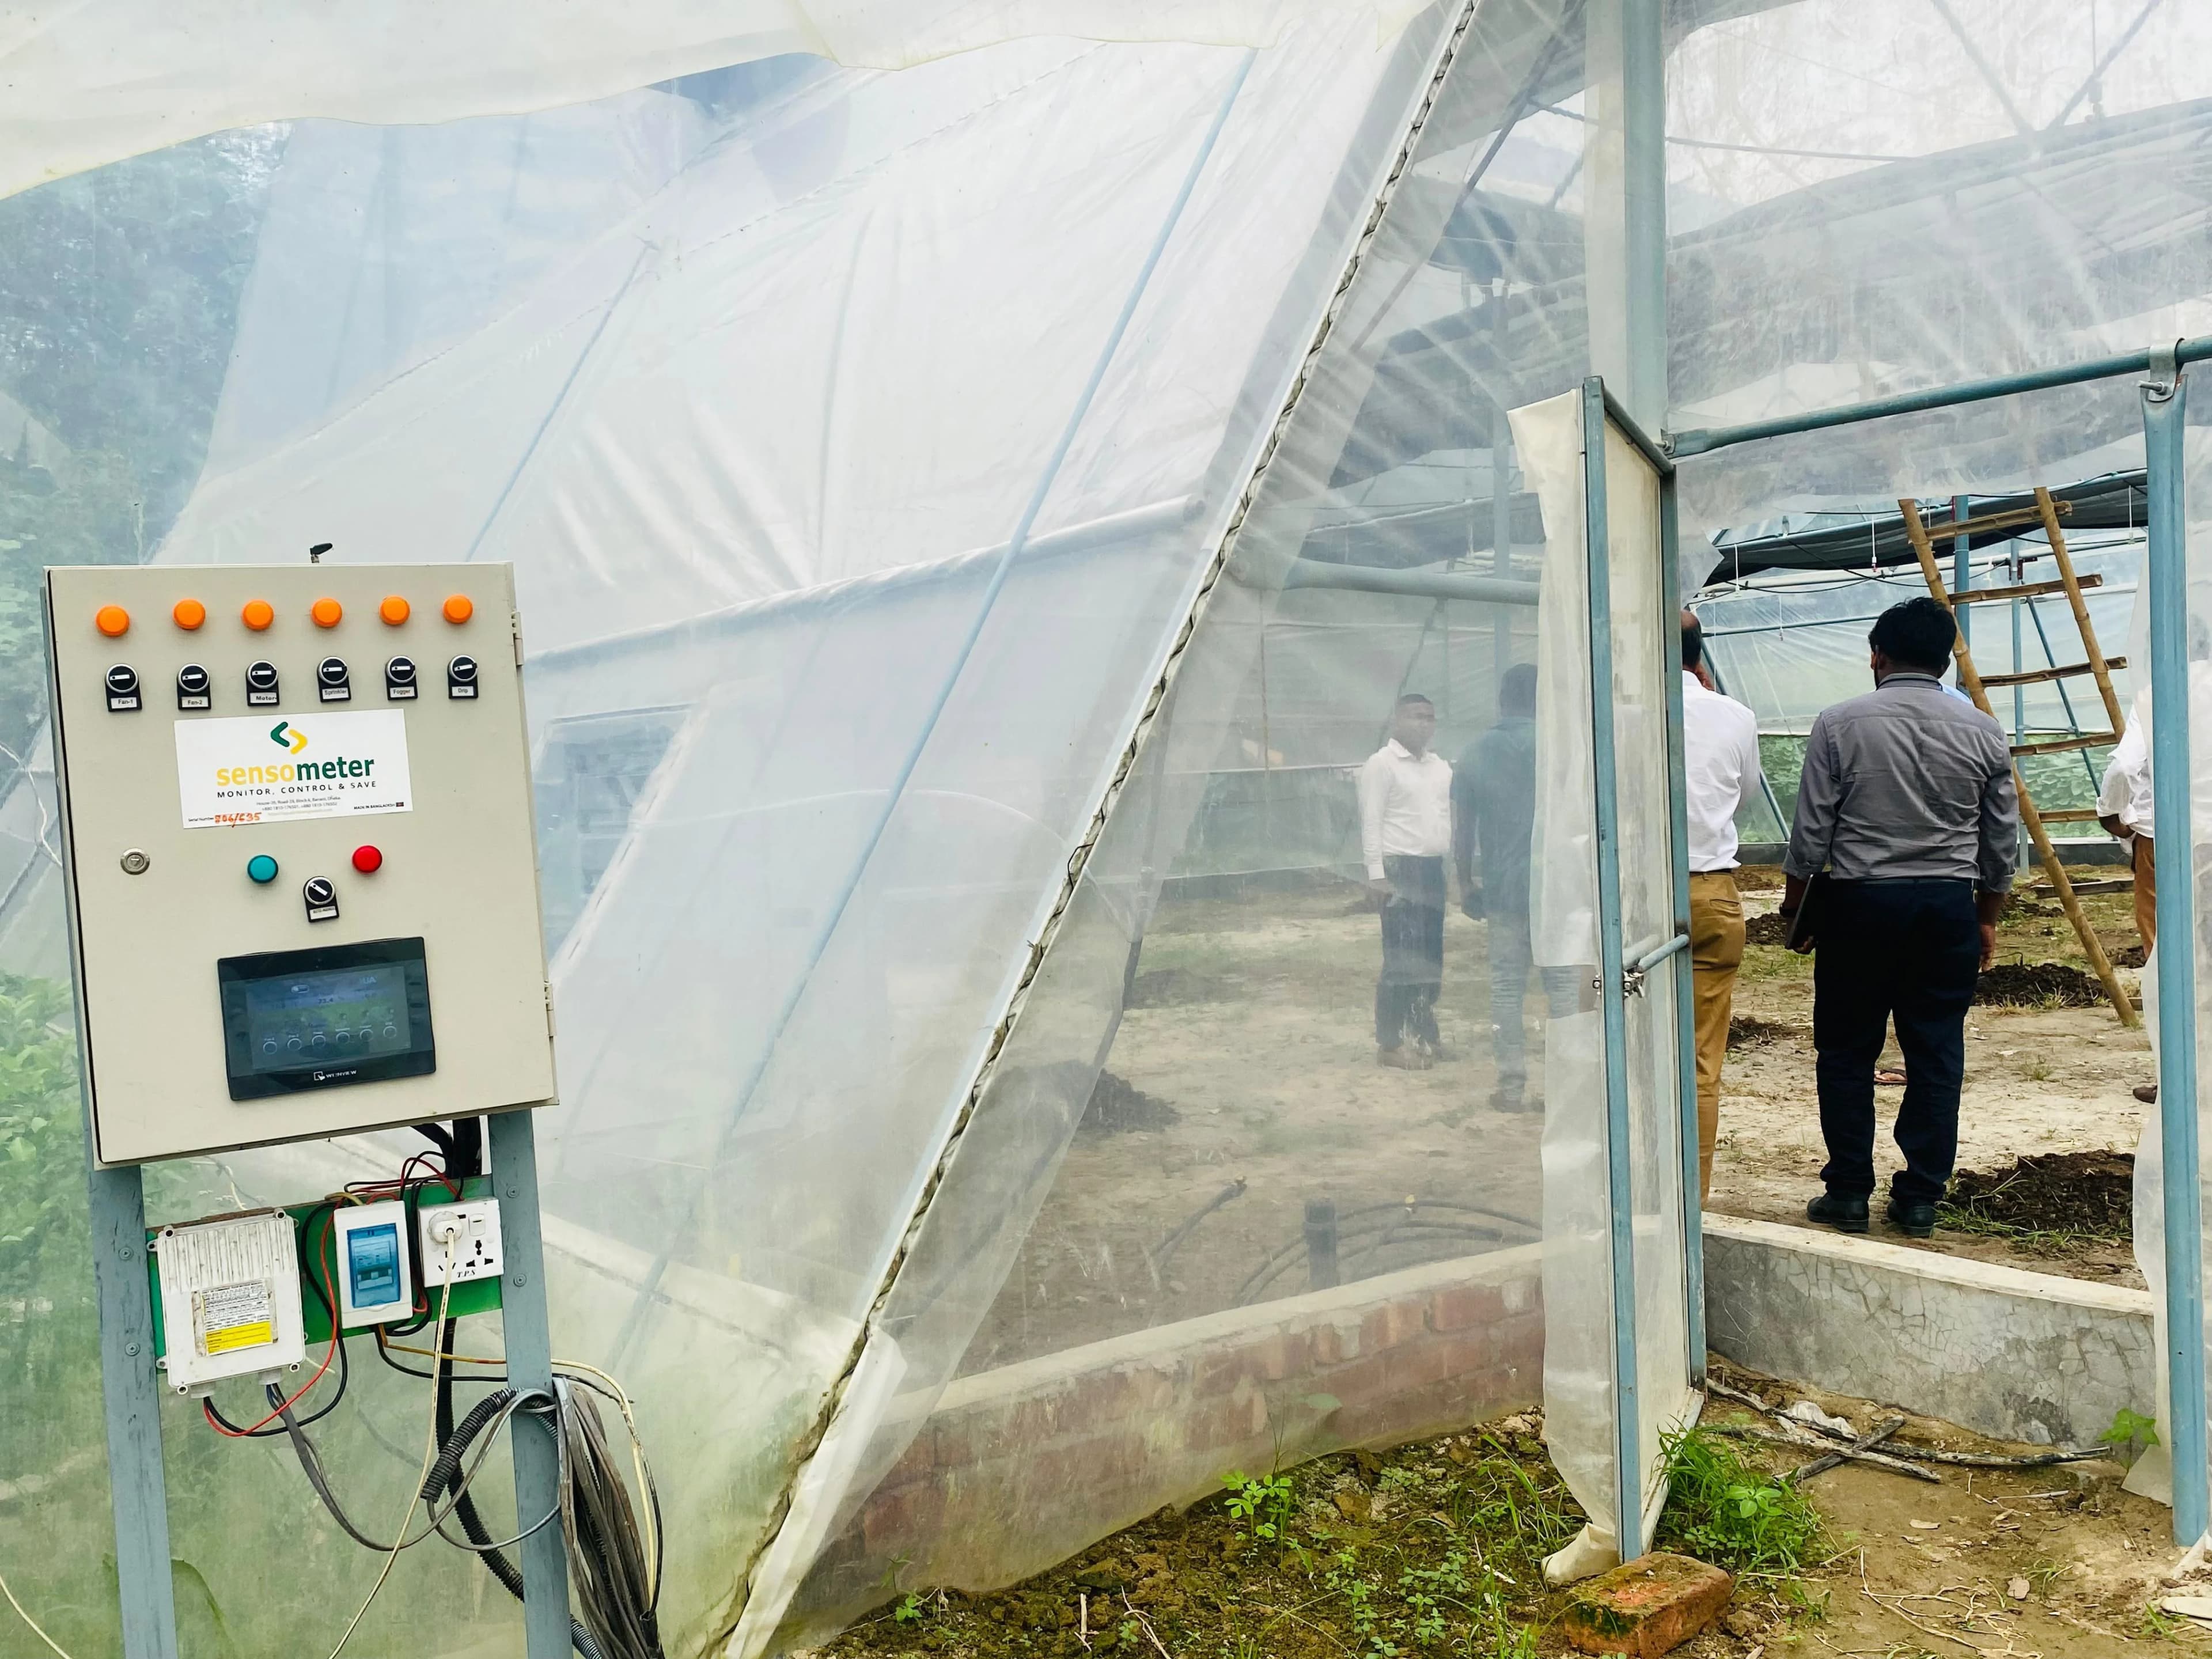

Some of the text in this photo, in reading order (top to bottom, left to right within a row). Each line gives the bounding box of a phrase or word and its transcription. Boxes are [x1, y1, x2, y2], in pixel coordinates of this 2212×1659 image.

[216, 756, 375, 787] sensometer
[217, 788, 275, 798] MONITOR,
[281, 783, 334, 794] CONTROL
[351, 781, 377, 789] SAVE
